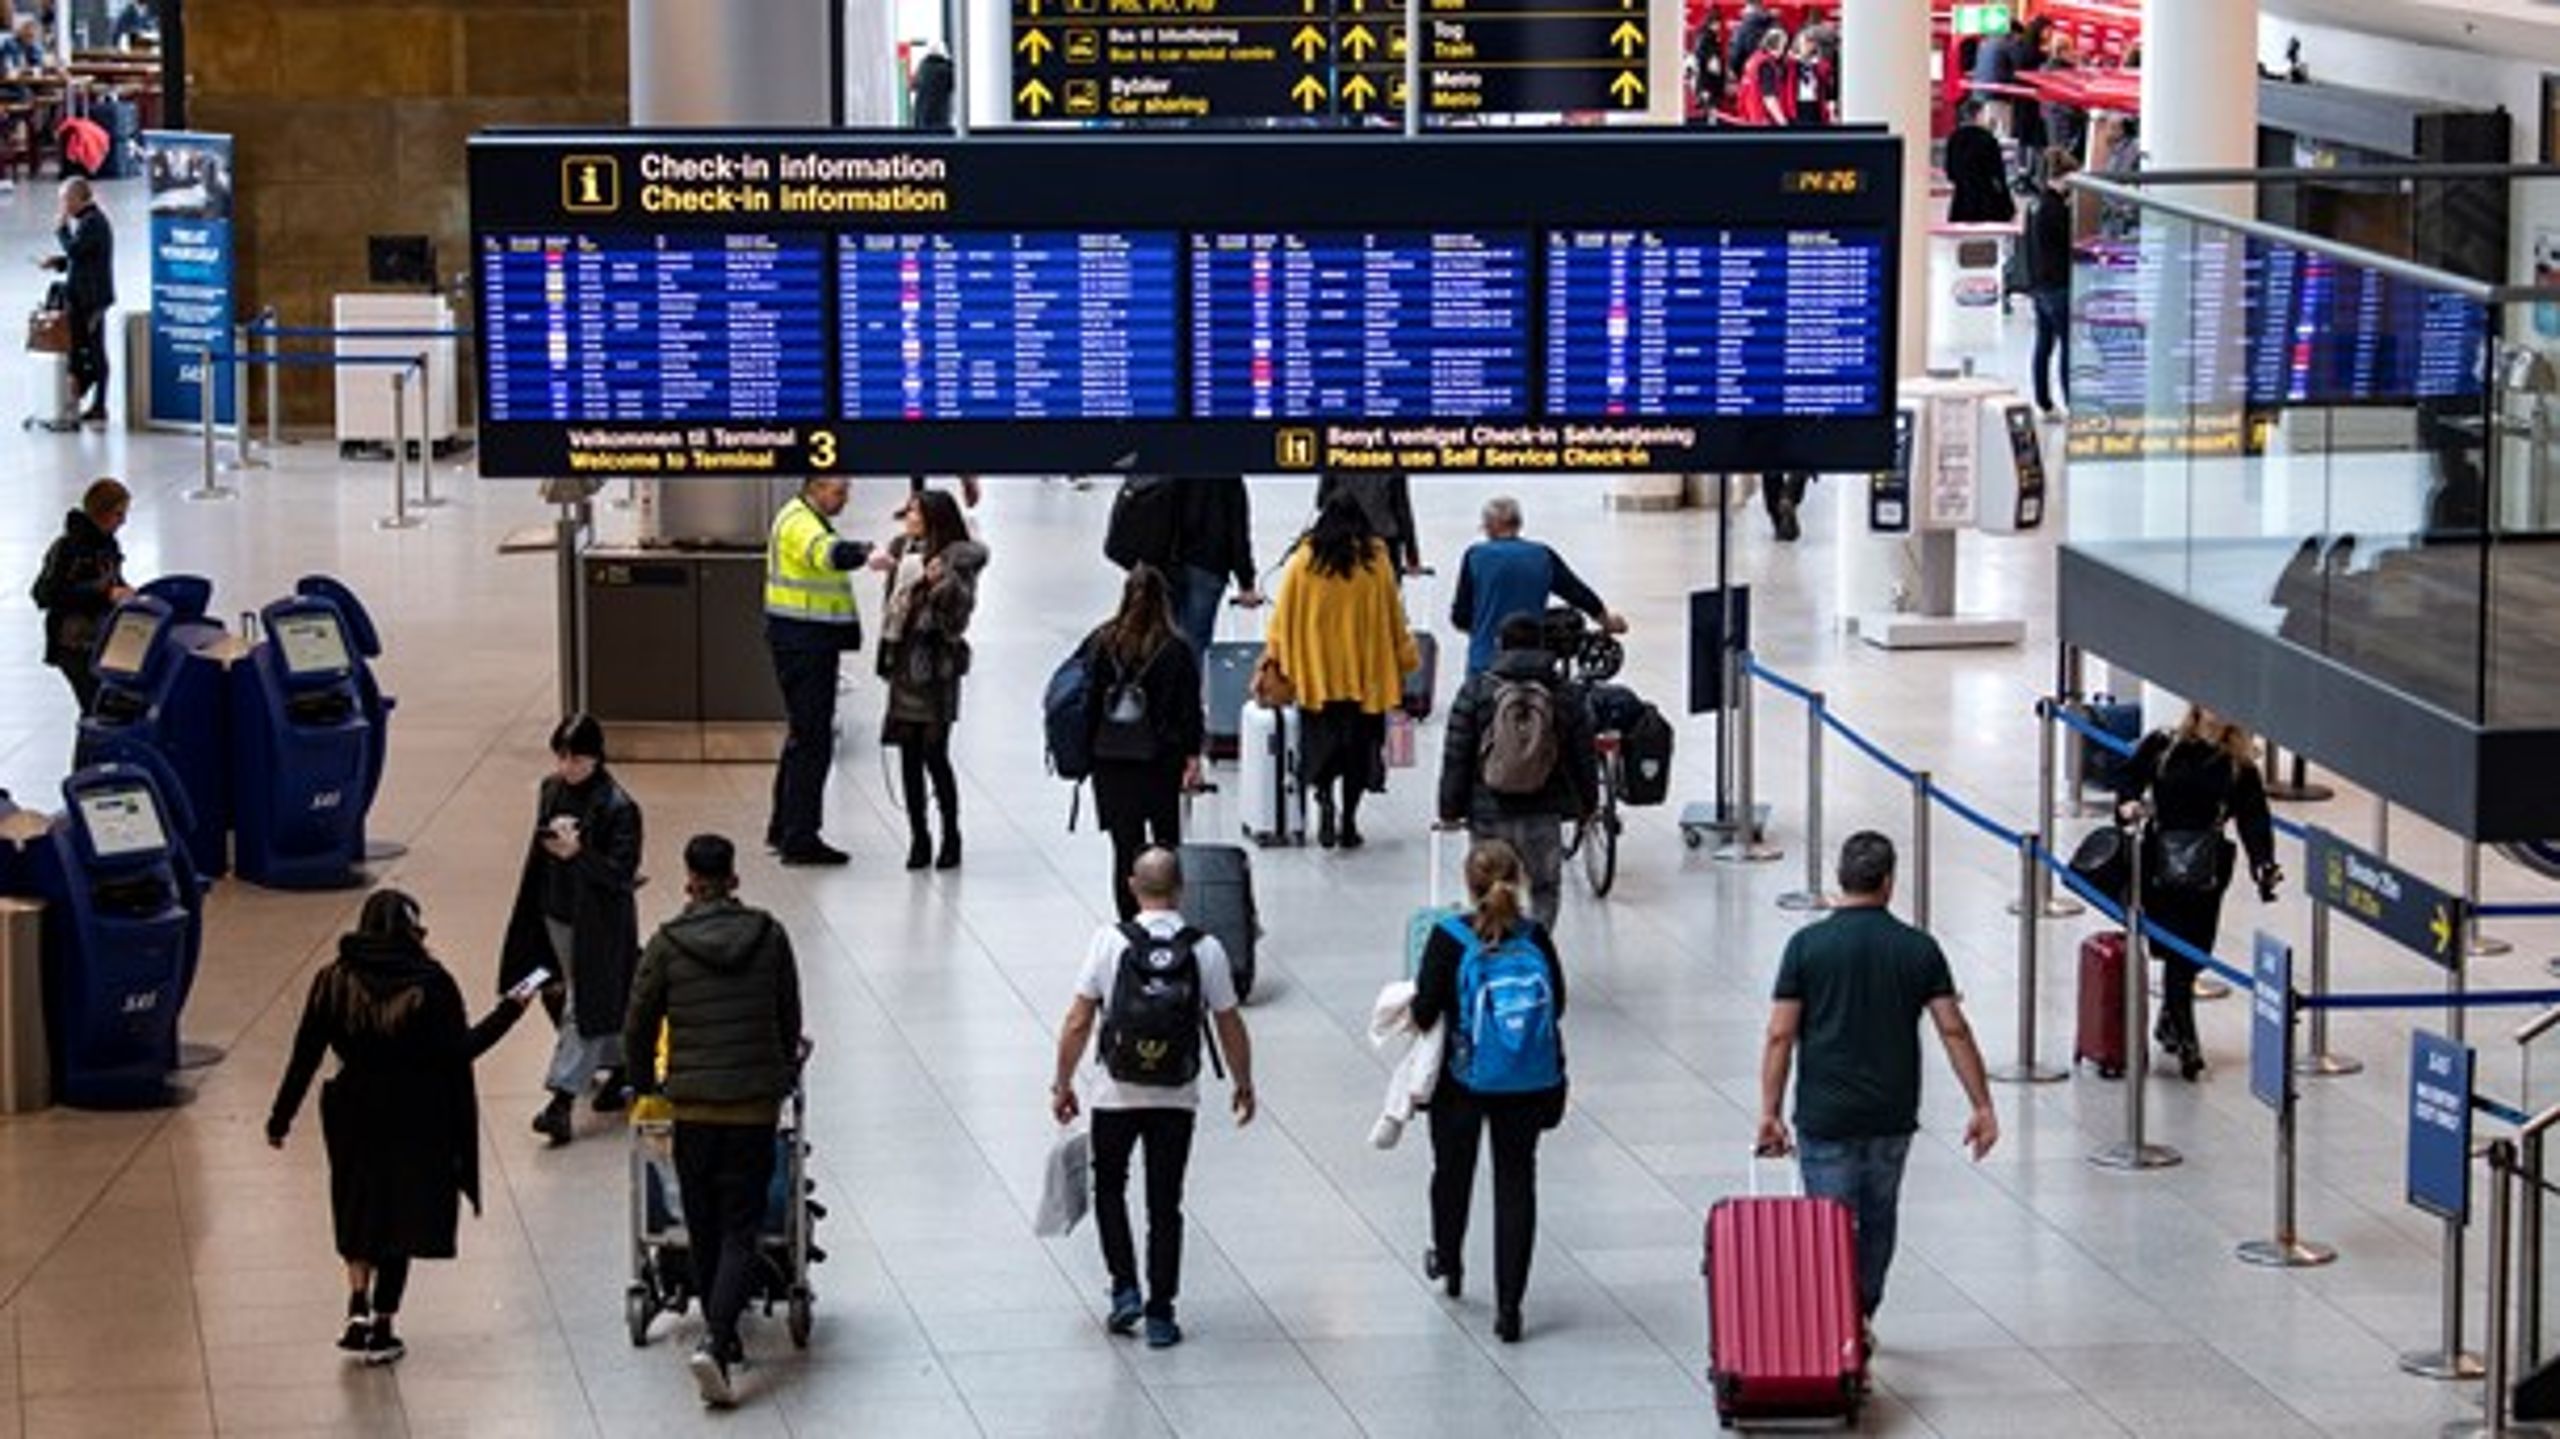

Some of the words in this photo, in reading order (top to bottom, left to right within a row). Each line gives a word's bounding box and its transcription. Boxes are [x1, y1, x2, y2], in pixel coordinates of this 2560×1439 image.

[1434, 21, 1464, 40] Tog
[1433, 42, 1474, 57] Train
[1432, 71, 1481, 86] Metro
[1109, 97, 1139, 113] Car
[1145, 96, 1209, 115] sharing
[1432, 93, 1481, 108] Metro
[640, 154, 770, 180] Check-in
[640, 185, 770, 212] Check-in
[568, 429, 681, 446] Velkommen
[713, 428, 795, 446] Terminal
[1473, 427, 1557, 445] Check-in
[809, 431, 836, 468] 3
[1328, 449, 1393, 467] Please
[1399, 452, 1436, 467] use
[1442, 449, 1479, 467] Self
[1486, 449, 1557, 466] Service
[1564, 449, 1650, 466] Check-in
[570, 452, 660, 468] Welcome
[667, 453, 685, 468] to
[693, 451, 774, 468] Terminal
